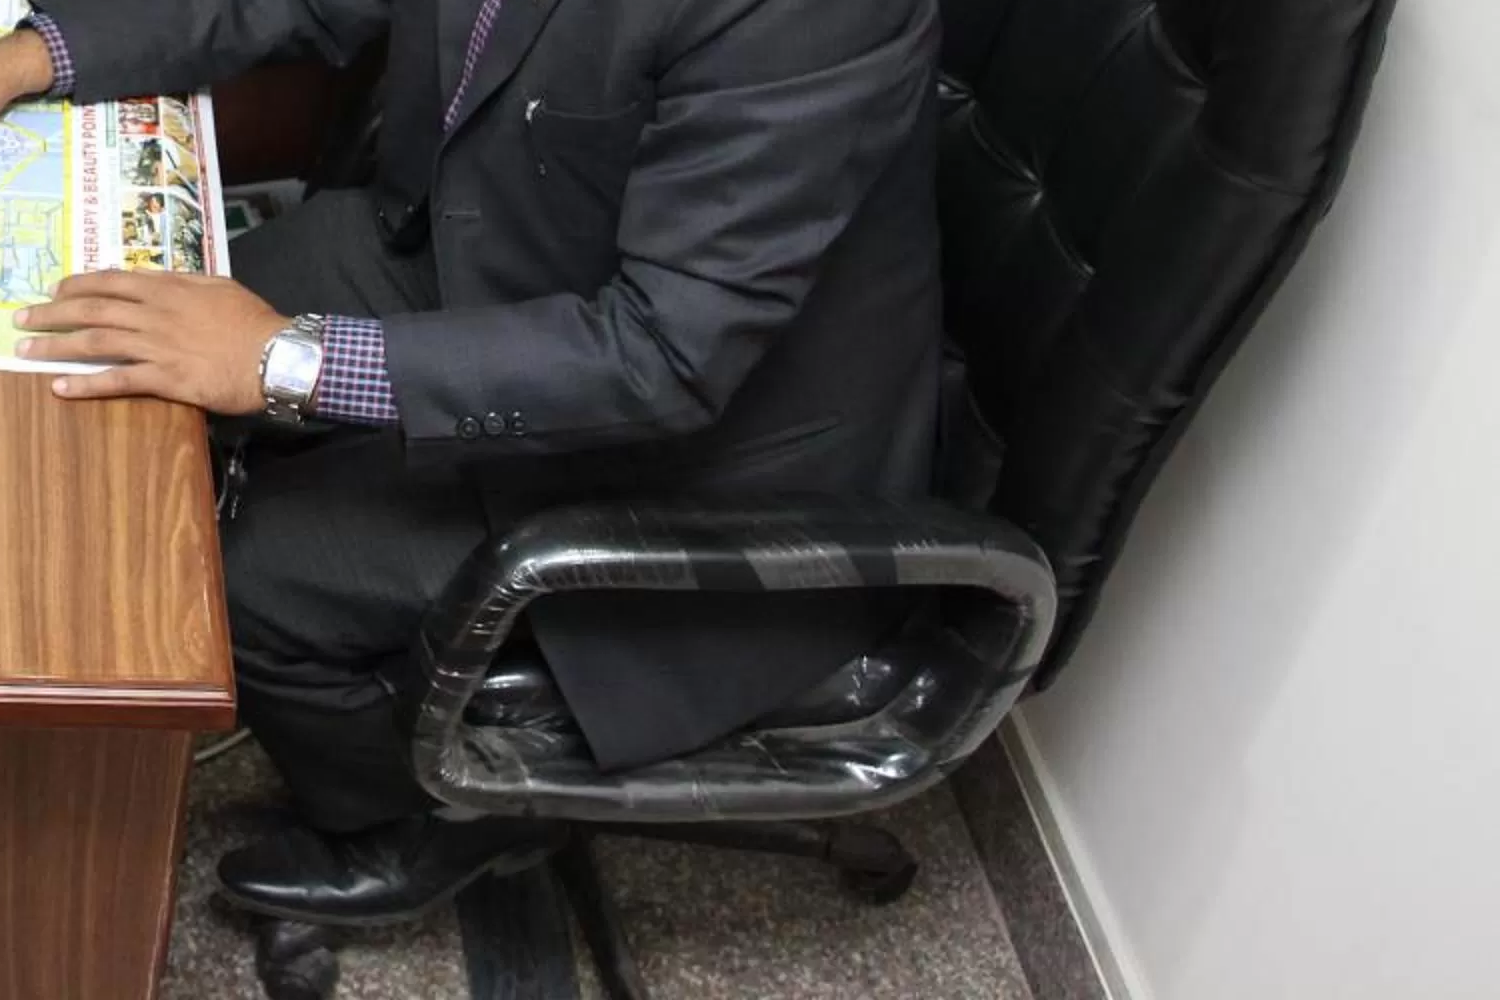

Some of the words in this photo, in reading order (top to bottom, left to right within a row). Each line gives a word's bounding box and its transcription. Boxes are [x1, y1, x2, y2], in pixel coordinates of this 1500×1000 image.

[82, 142, 98, 190] BEAUTY
[83, 191, 99, 205] &
[83, 209, 99, 272] THERAPY
